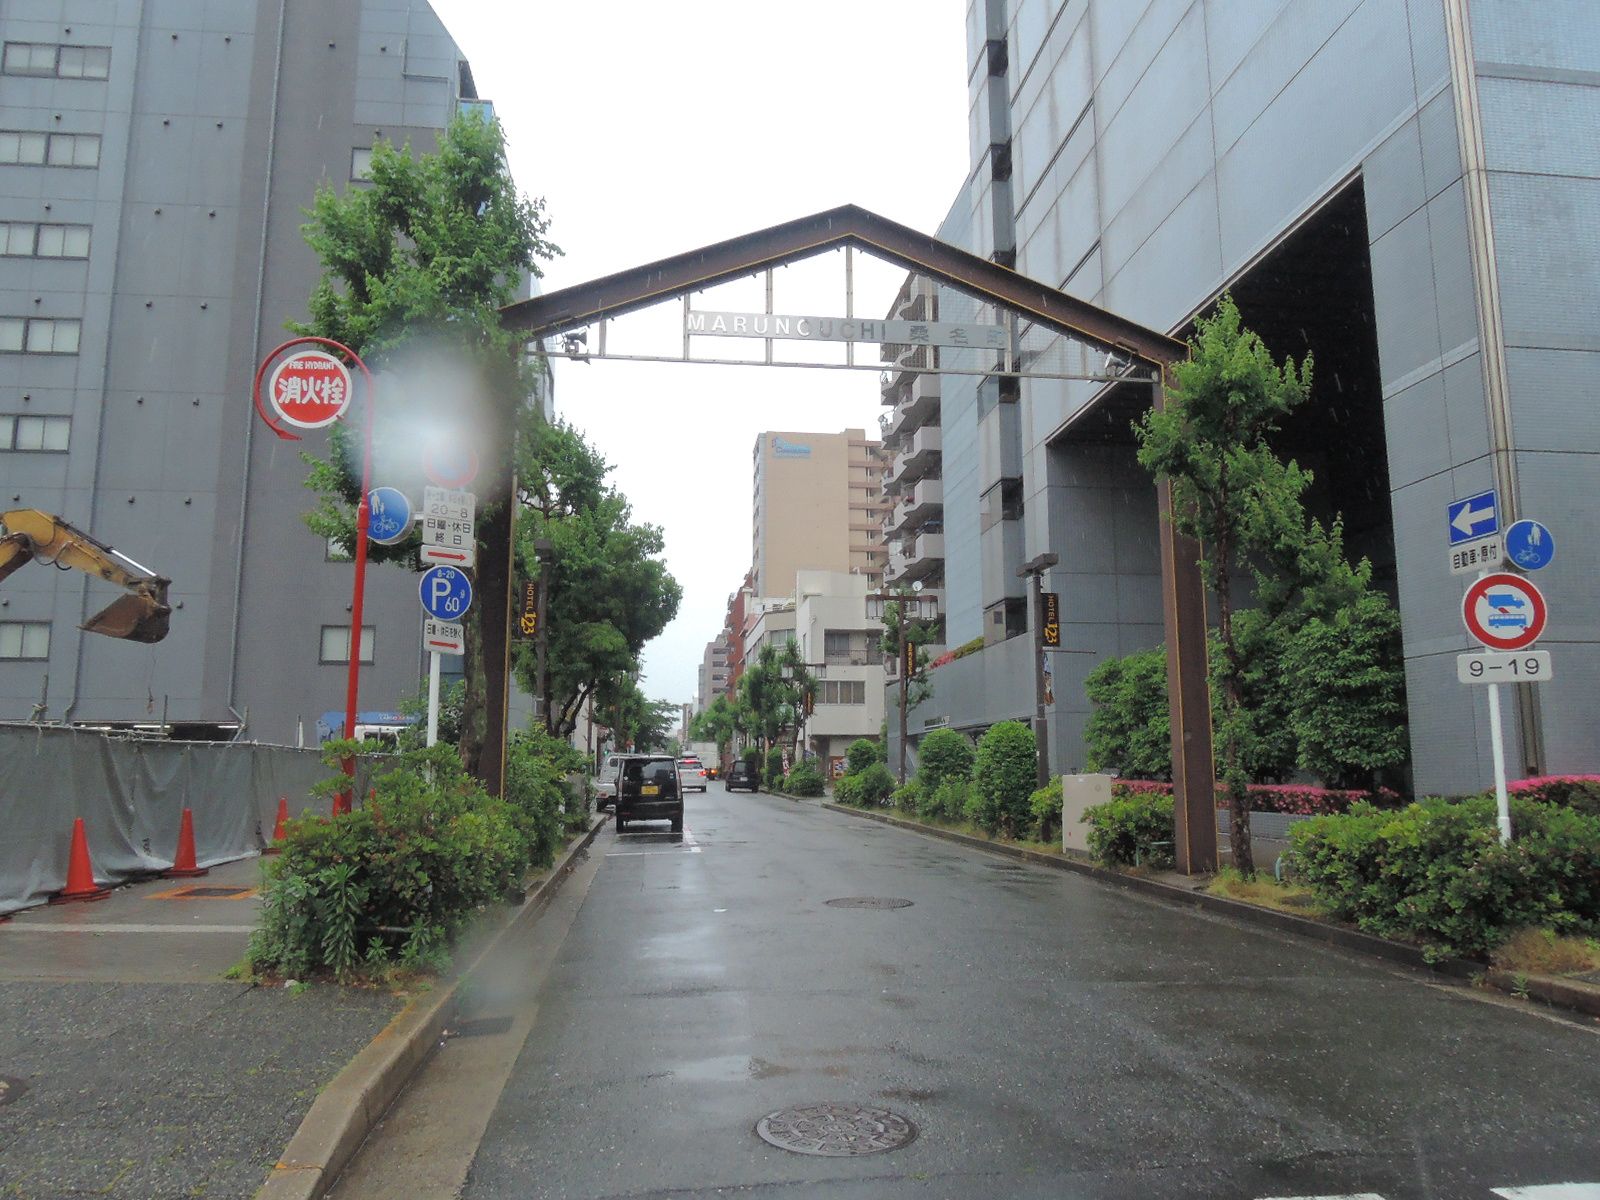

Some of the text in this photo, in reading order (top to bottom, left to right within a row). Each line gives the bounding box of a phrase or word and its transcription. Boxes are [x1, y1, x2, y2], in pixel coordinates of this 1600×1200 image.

[687, 313, 886, 340] MARUNOUCHI
[289, 361, 336, 370] FIRE HYDRANT
[278, 376, 344, 404] 消火栓
[431, 577, 452, 611] P
[521, 583, 537, 634] HOTEL 123
[1045, 623, 1058, 644] 123
